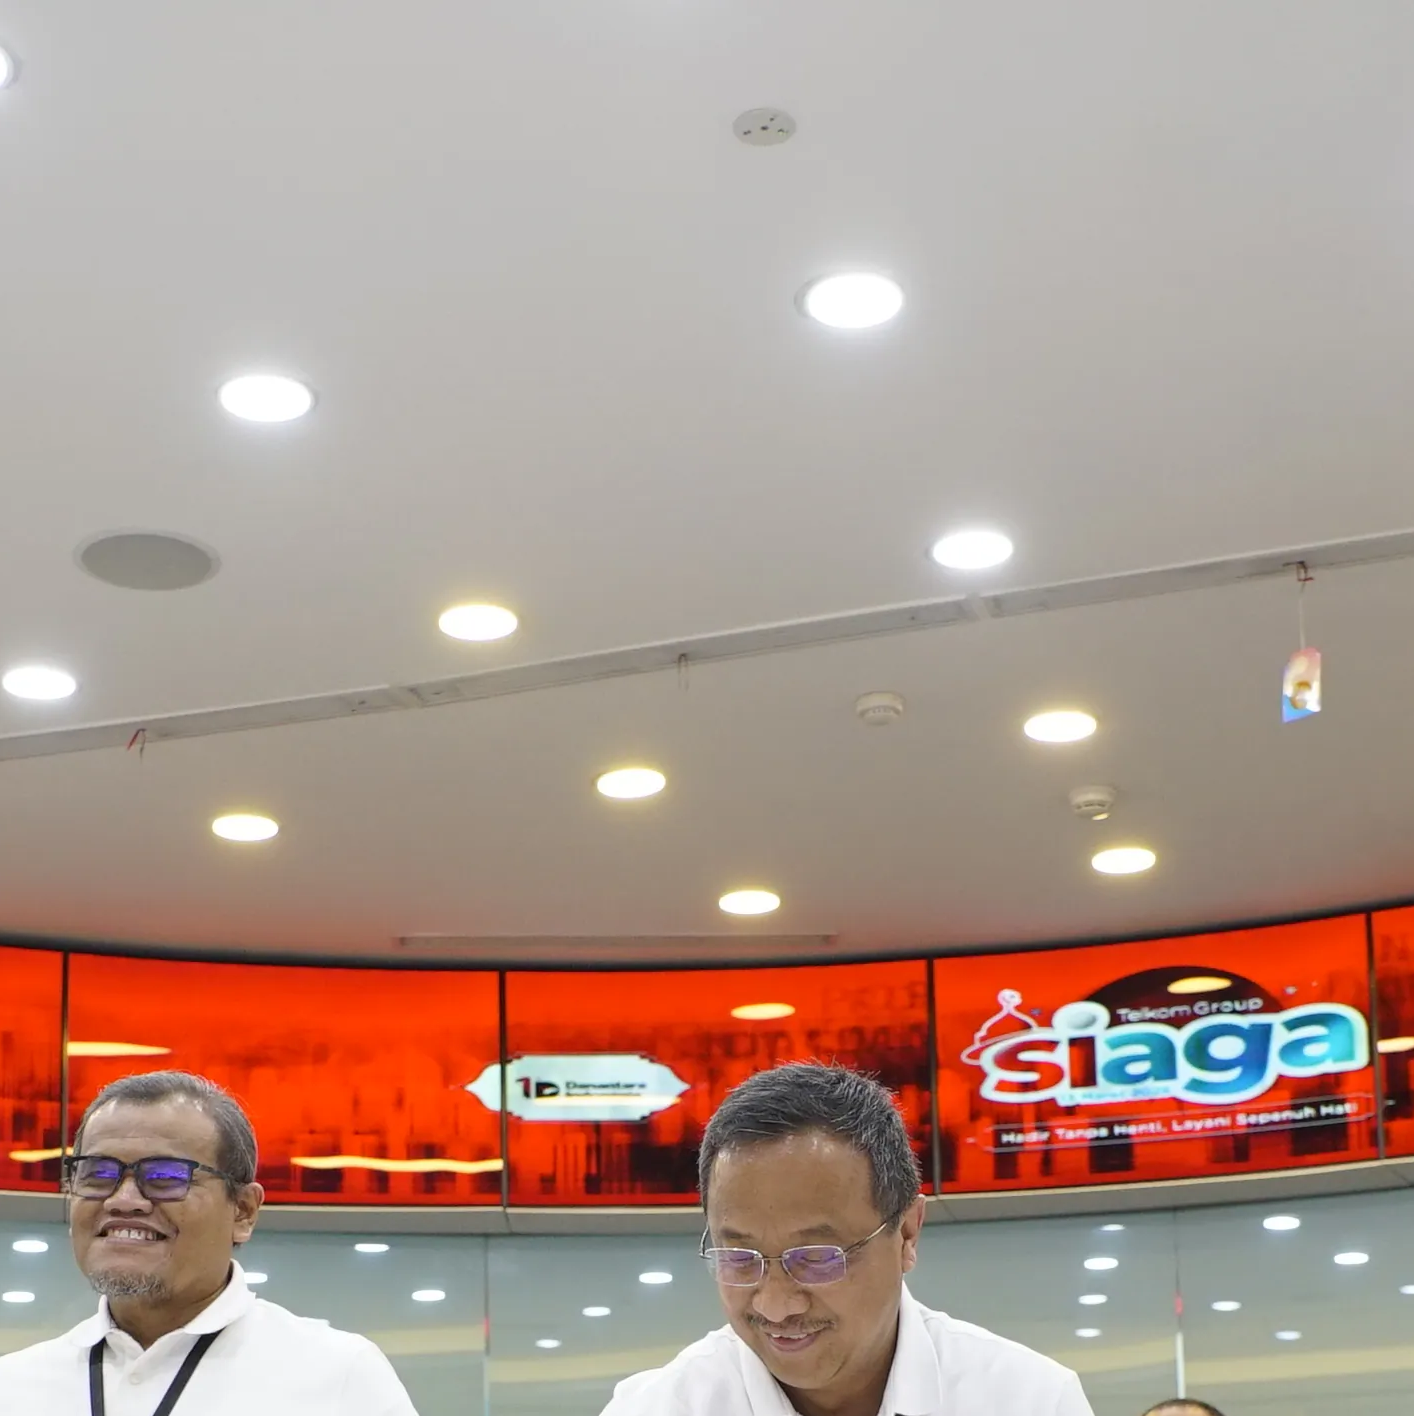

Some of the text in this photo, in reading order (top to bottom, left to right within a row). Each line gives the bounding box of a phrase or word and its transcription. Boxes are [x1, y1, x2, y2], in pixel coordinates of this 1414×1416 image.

[1116, 997, 1264, 1023] Telkom Group
[985, 1003, 1361, 1098] siaga
[1171, 1115, 1232, 1133] Layani
[1235, 1106, 1317, 1127] Sepenuh
[1319, 1102, 1359, 1117] Hati
